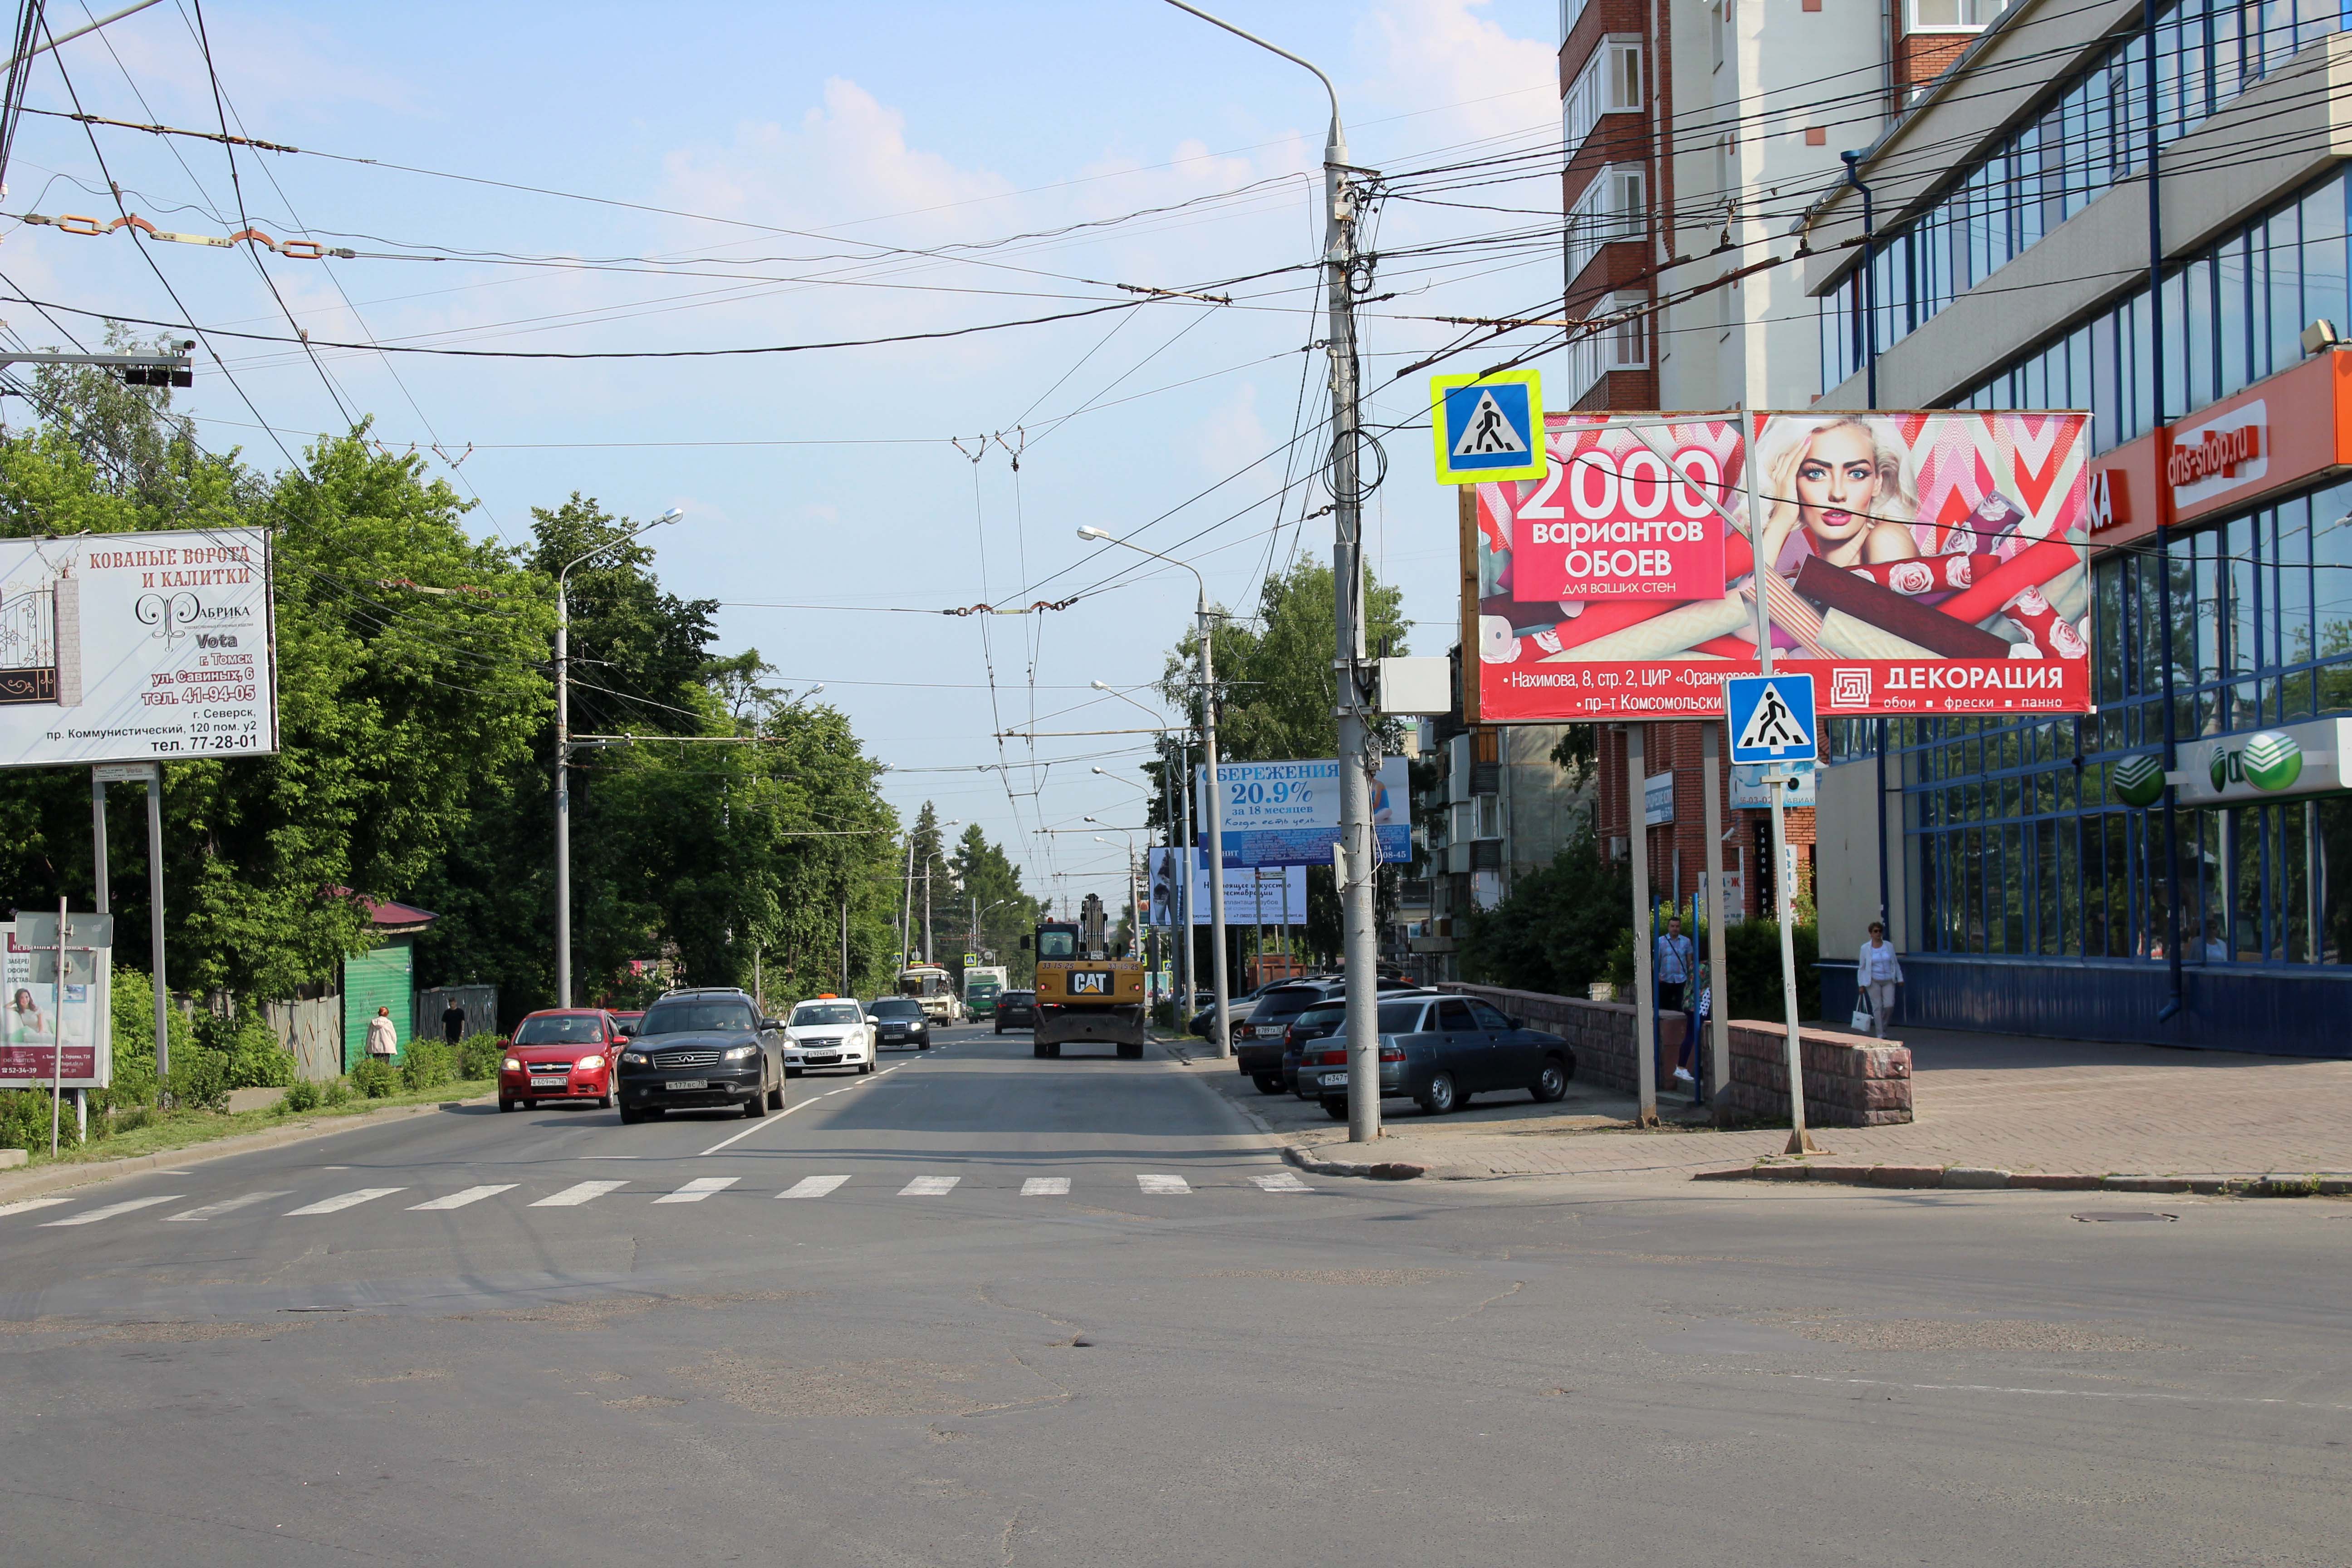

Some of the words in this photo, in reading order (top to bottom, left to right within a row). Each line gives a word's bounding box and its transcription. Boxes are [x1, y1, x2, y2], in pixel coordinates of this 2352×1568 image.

[2168, 426, 2248, 487] dns-shop.ru
[1517, 451, 1719, 519] 2000
[2090, 469, 2112, 529] КА
[1533, 521, 1703, 549] вариантов
[90, 549, 176, 568] КОВАНЫЕ
[183, 546, 250, 564] ВОРОТА
[1565, 549, 1672, 577] ОБОЕВ
[142, 573, 154, 588] И
[161, 568, 250, 587] КАЛИТКИ
[1563, 584, 1587, 595] для
[1591, 583, 1639, 593] ваших
[1642, 582, 1676, 593] стен
[196, 633, 238, 648] Vota
[200, 656, 208, 666] г.
[211, 653, 253, 665] Томск
[152, 673, 174, 686] ул.
[176, 669, 243, 683] Савиных,
[245, 667, 254, 680] 6
[1512, 671, 1579, 689] Нахимова,
[1583, 670, 1594, 688] 8,
[1598, 673, 1622, 689] стр.
[1626, 670, 1637, 688] 2,
[1642, 669, 1671, 687] ЦИР
[1884, 667, 2063, 689] ДЕКОРАЦИЯ
[142, 692, 179, 706] тел.
[182, 685, 256, 703] 41-94-05
[1621, 694, 1724, 710] Комсомольски
[1884, 696, 1916, 708] обои
[1945, 696, 1994, 710] фрески
[2022, 698, 2062, 708] панно
[204, 708, 256, 720] Северск,
[47, 731, 64, 742] пр.
[68, 724, 186, 740] Коммунистический,
[190, 723, 209, 733] 120
[214, 723, 240, 732] пом.
[151, 740, 184, 752] тел.
[190, 735, 257, 750] 77-28-01
[1231, 781, 1313, 804] 20.9%
[1250, 806, 1261, 814] 18
[1264, 805, 1313, 814] месяцев
[1225, 817, 1256, 829] Когда
[1251, 882, 1291, 891] икуссто
[1074, 973, 1106, 993] CAT
